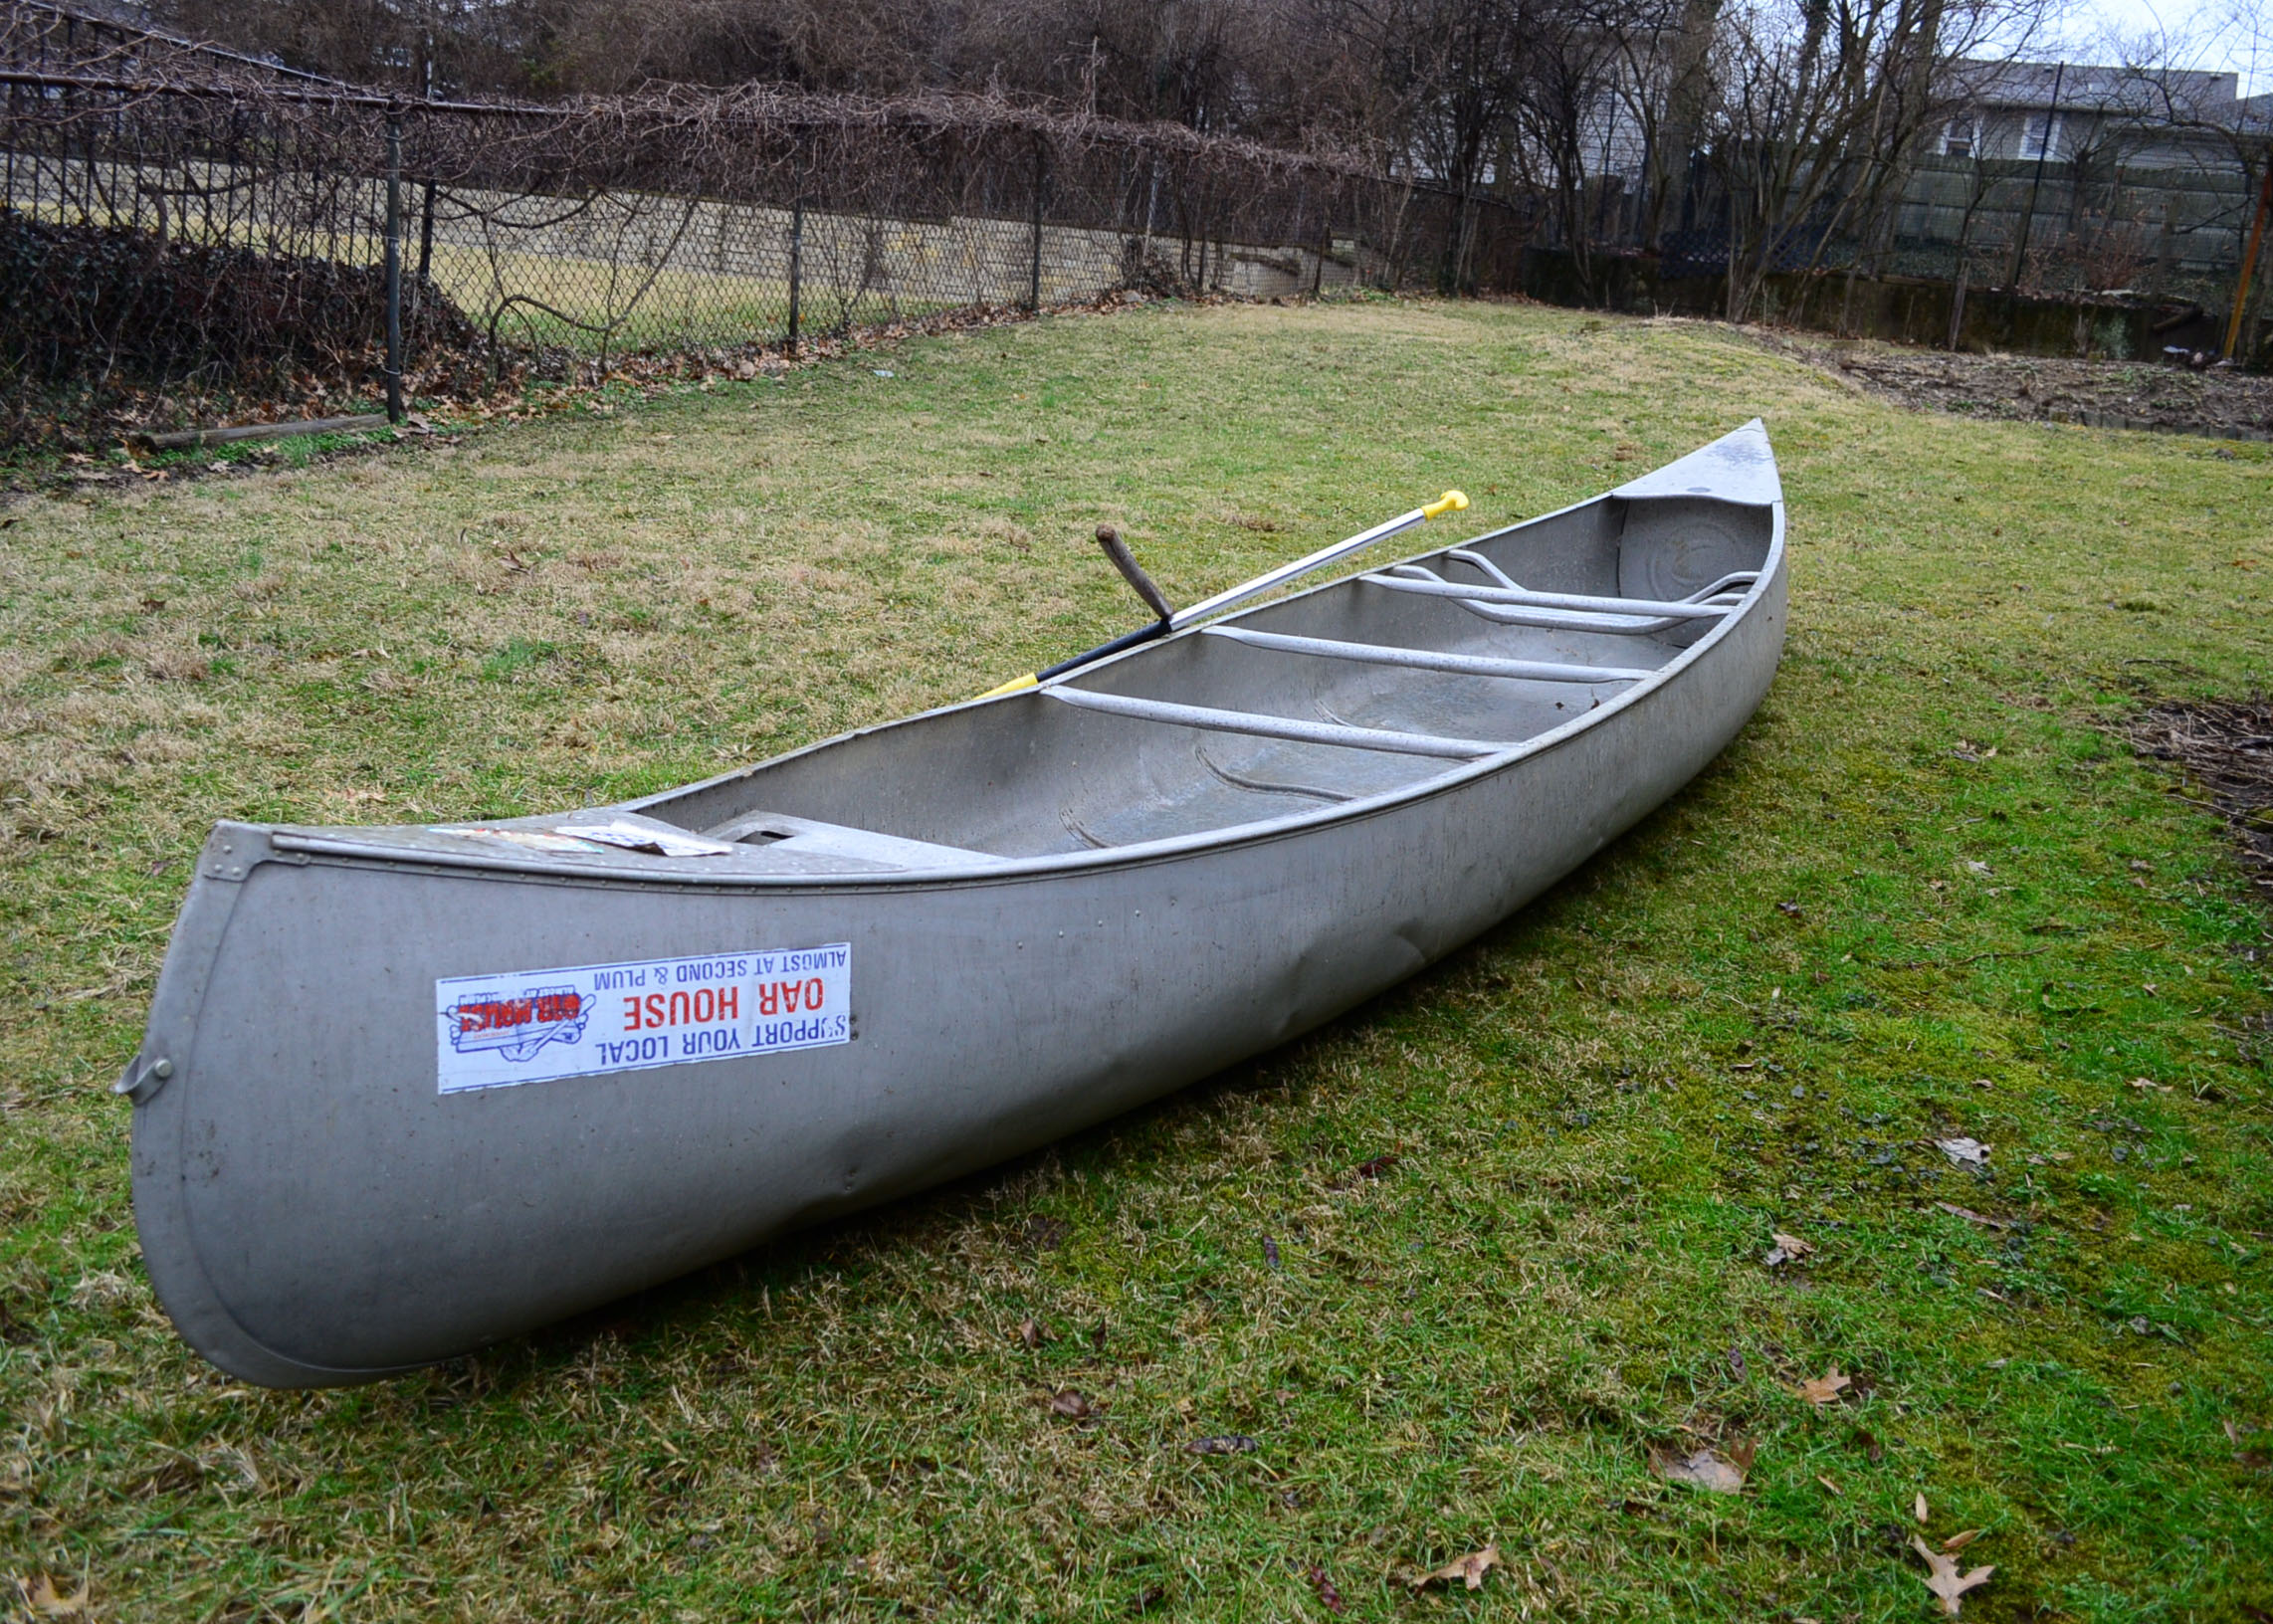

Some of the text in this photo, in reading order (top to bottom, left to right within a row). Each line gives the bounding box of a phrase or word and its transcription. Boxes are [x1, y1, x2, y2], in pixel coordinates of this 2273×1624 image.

[594, 950, 847, 991] ALMOST AT SECOND & PLUM
[623, 977, 824, 1031] OAR HOUSE
[595, 1035, 669, 1065] LOCAL
[683, 1028, 740, 1055] YOUR
